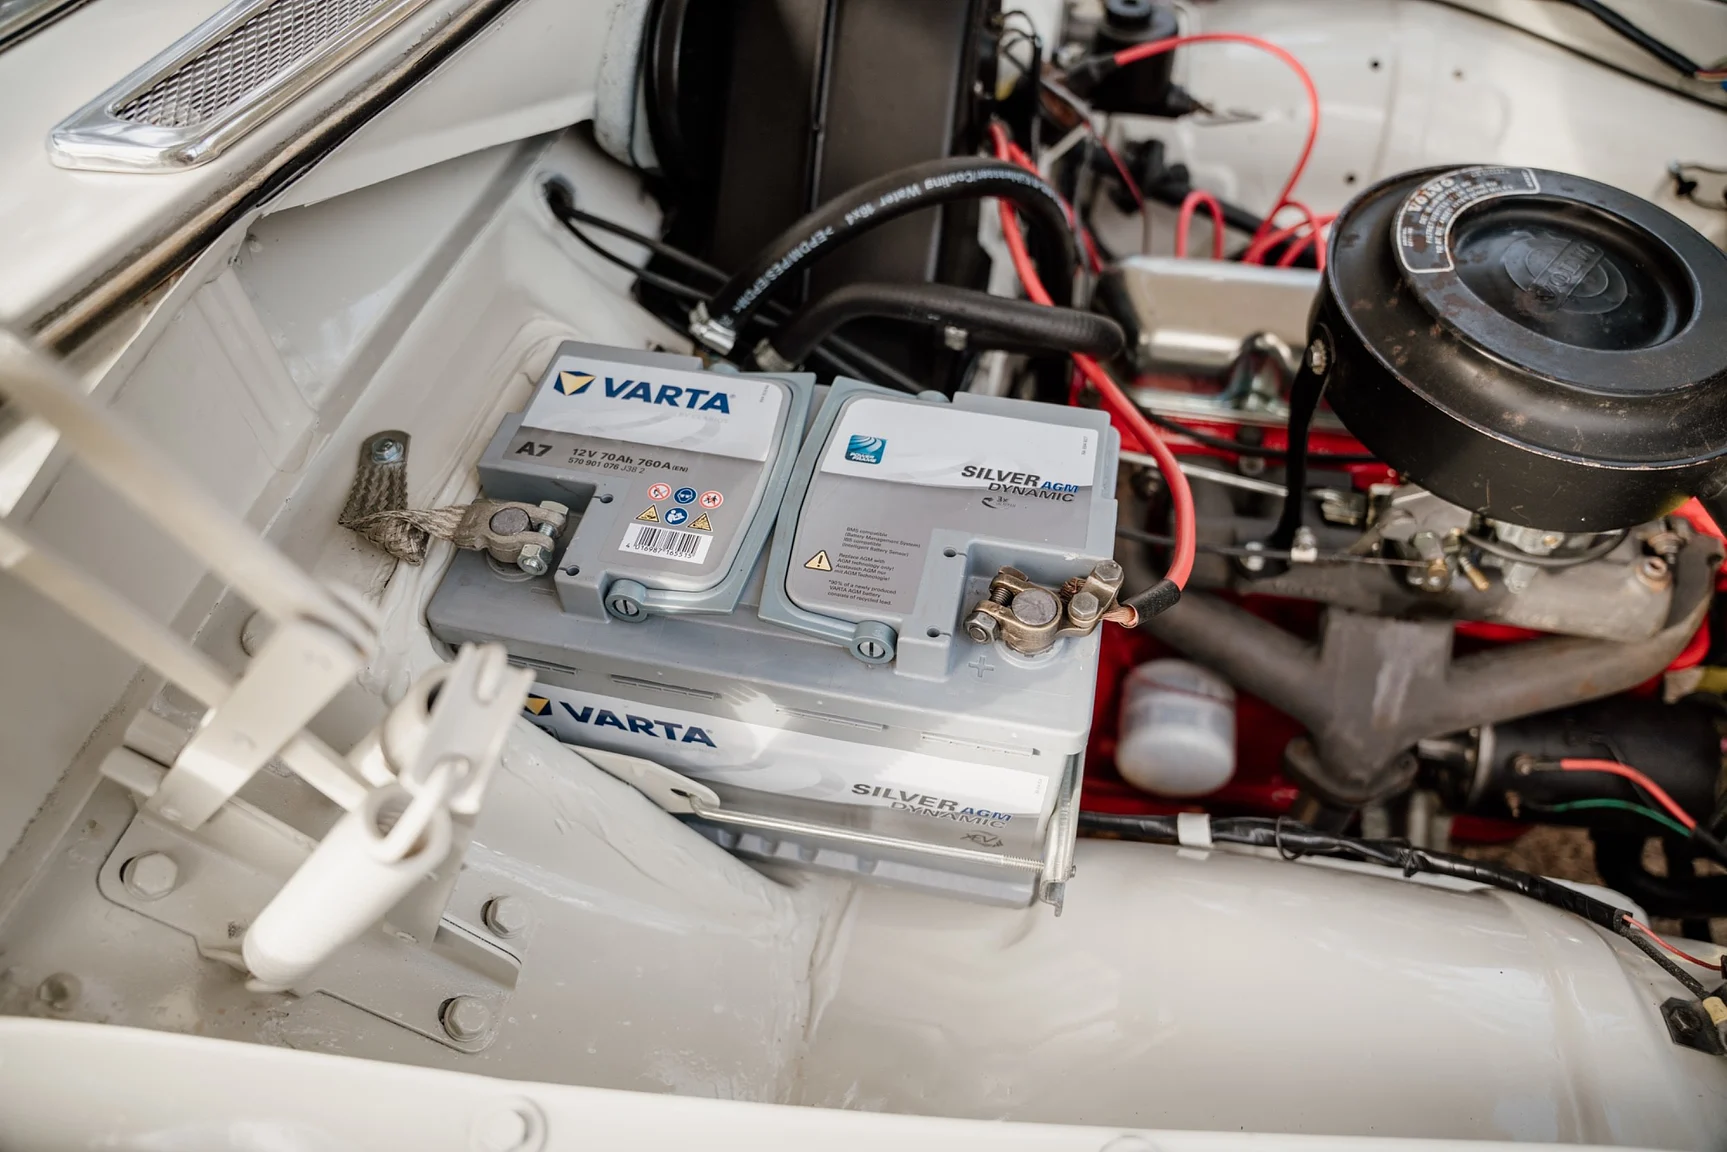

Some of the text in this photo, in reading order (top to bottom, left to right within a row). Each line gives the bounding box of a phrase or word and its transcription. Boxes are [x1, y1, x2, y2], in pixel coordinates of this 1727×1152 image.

[880, 183, 922, 207] Water
[1407, 179, 1455, 211] VOLVO
[605, 377, 730, 414] VARTA
[516, 441, 552, 457] A7
[572, 448, 597, 458] 12V
[600, 452, 633, 464] 70Ah
[568, 457, 584, 465] 570
[603, 462, 619, 470] 076
[961, 465, 1079, 493] SILVER AGM
[987, 482, 1075, 502] DYNAMIC
[559, 701, 718, 748] VARTA
[851, 783, 1012, 822] SILVER AGM
[891, 801, 1007, 829] DYNAMIC
